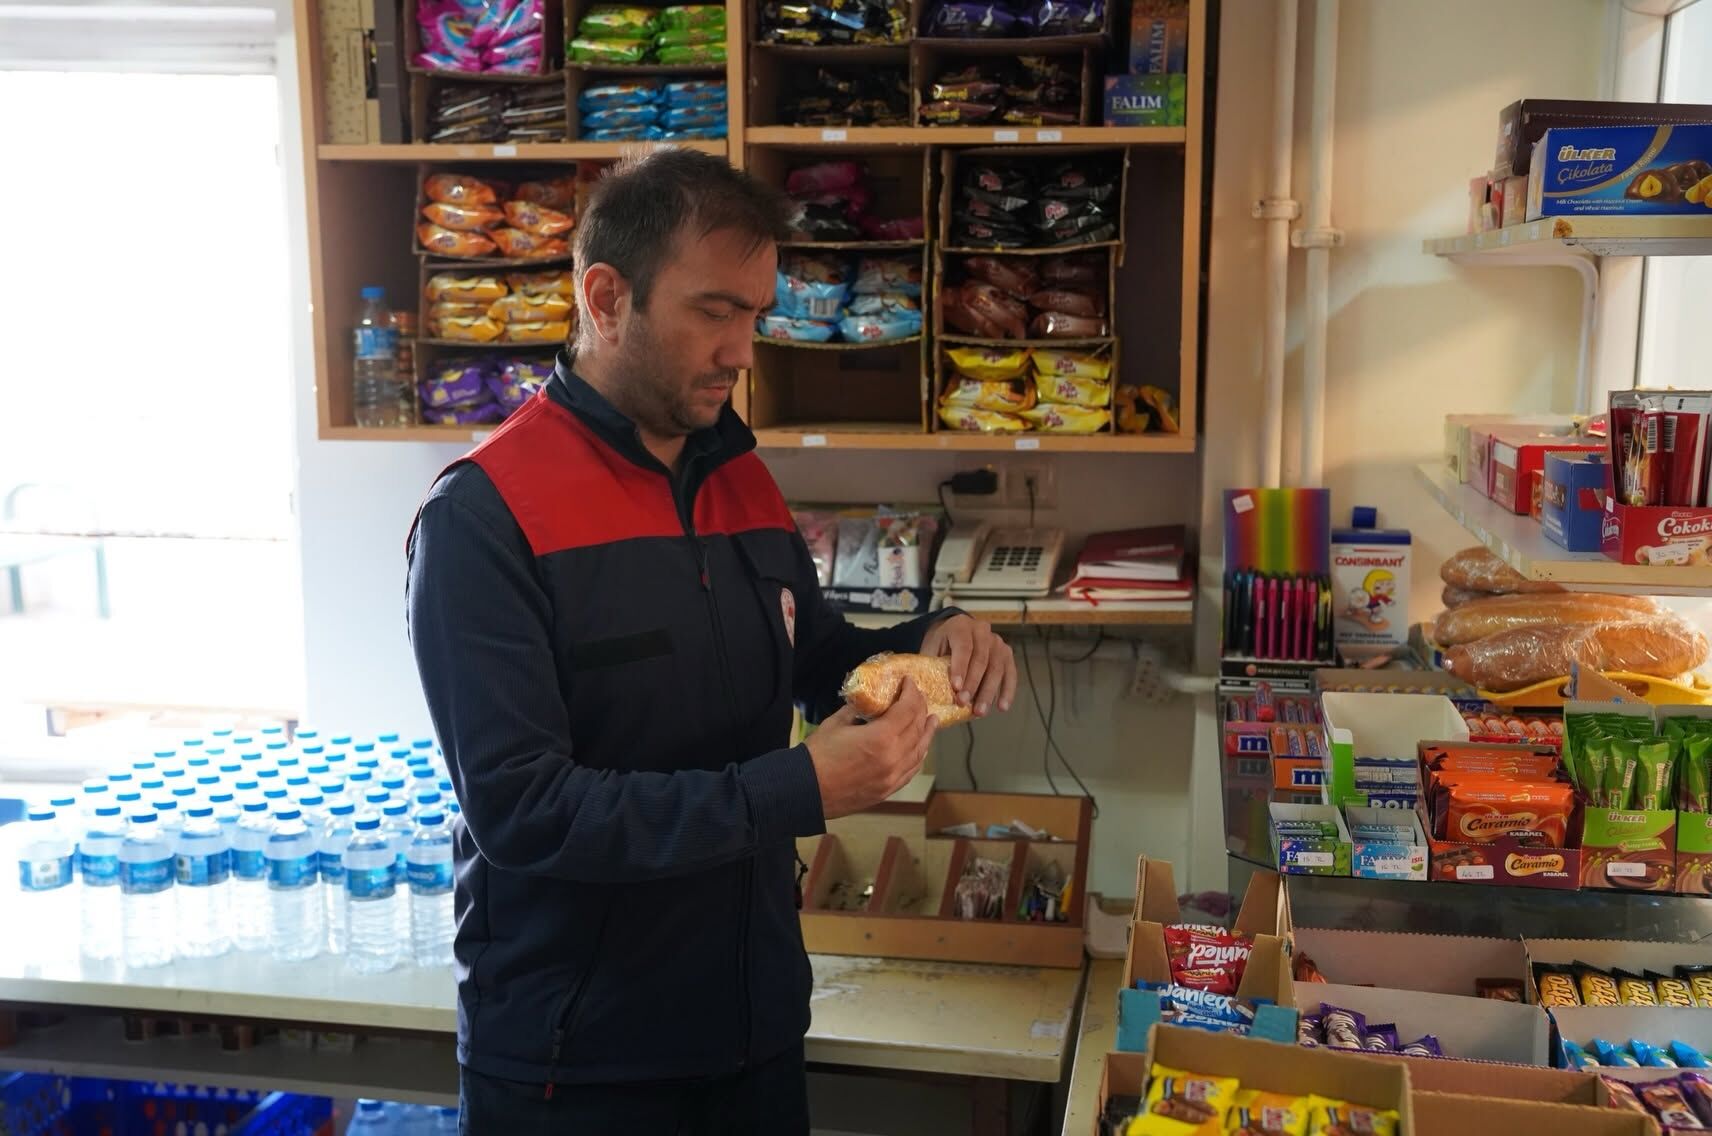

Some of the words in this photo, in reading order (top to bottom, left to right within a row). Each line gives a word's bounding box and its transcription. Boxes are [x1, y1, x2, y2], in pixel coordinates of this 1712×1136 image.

[1112, 96, 1161, 110] FALIM
[1558, 145, 1617, 162] ÜLKER
[1557, 161, 1613, 185] Çikolata
[1467, 817, 1530, 831] Caramio
[1608, 812, 1646, 823] ÜLKER
[1511, 859, 1559, 870] Caramio
